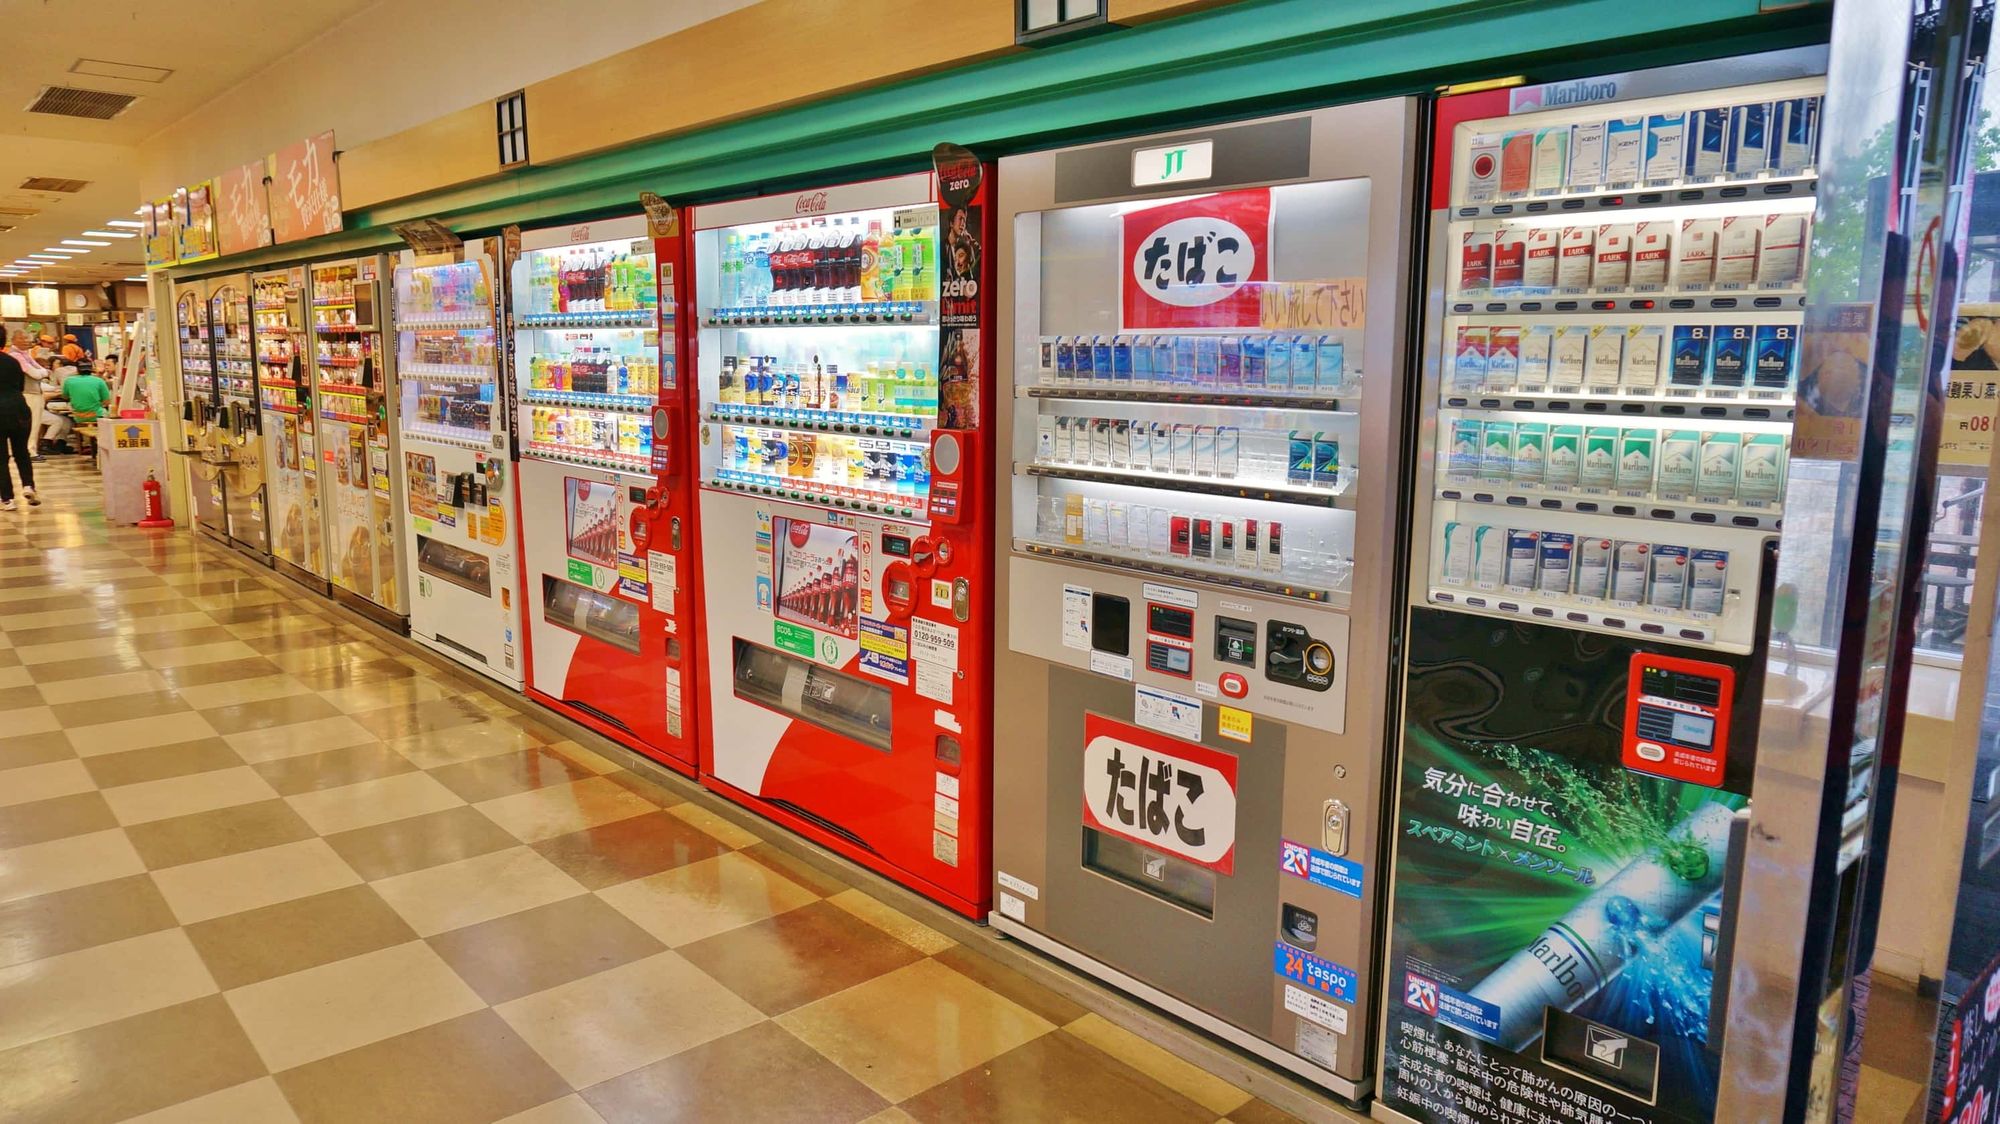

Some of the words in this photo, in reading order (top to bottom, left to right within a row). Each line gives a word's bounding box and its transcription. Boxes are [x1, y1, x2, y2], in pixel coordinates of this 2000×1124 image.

[1544, 81, 1617, 107] Marlboro
[1582, 135, 1602, 143] KENT
[1618, 140, 1640, 148] KENT
[1161, 149, 1188, 180] JT
[949, 179, 970, 191] zero
[1532, 249, 1550, 257] LARK
[1567, 247, 1586, 256] LARK
[1603, 253, 1621, 261] LARK
[1640, 252, 1660, 260] LARK
[1686, 250, 1706, 258] LARK
[1144, 231, 1240, 290] たばこ
[942, 277, 978, 298] zero
[1692, 328, 1704, 340] 8
[1733, 328, 1745, 340] 8
[1776, 328, 1789, 340] 8
[117, 438, 150, 448] 投函箱
[1586, 457, 1613, 469] Marlboro
[1623, 459, 1649, 472] Marlboro
[1664, 461, 1692, 475] Marlboro
[1703, 464, 1733, 478] Marlboro
[1744, 466, 1776, 479] Marlboro
[1106, 747, 1206, 847] たばこ
[1421, 766, 1559, 819] 気分に合わせて、
[1456, 803, 1567, 853] 味わい自在。
[1284, 841, 1309, 857] UNDER
[1282, 849, 1308, 879] 20
[1285, 952, 1305, 975] 24
[1306, 962, 1347, 988] taspo
[1408, 975, 1436, 992] UNDER
[1407, 982, 1436, 1011] 20
[1400, 1021, 1653, 1124] 喫煙は、あなたにとって肺がんの原因の一つ
